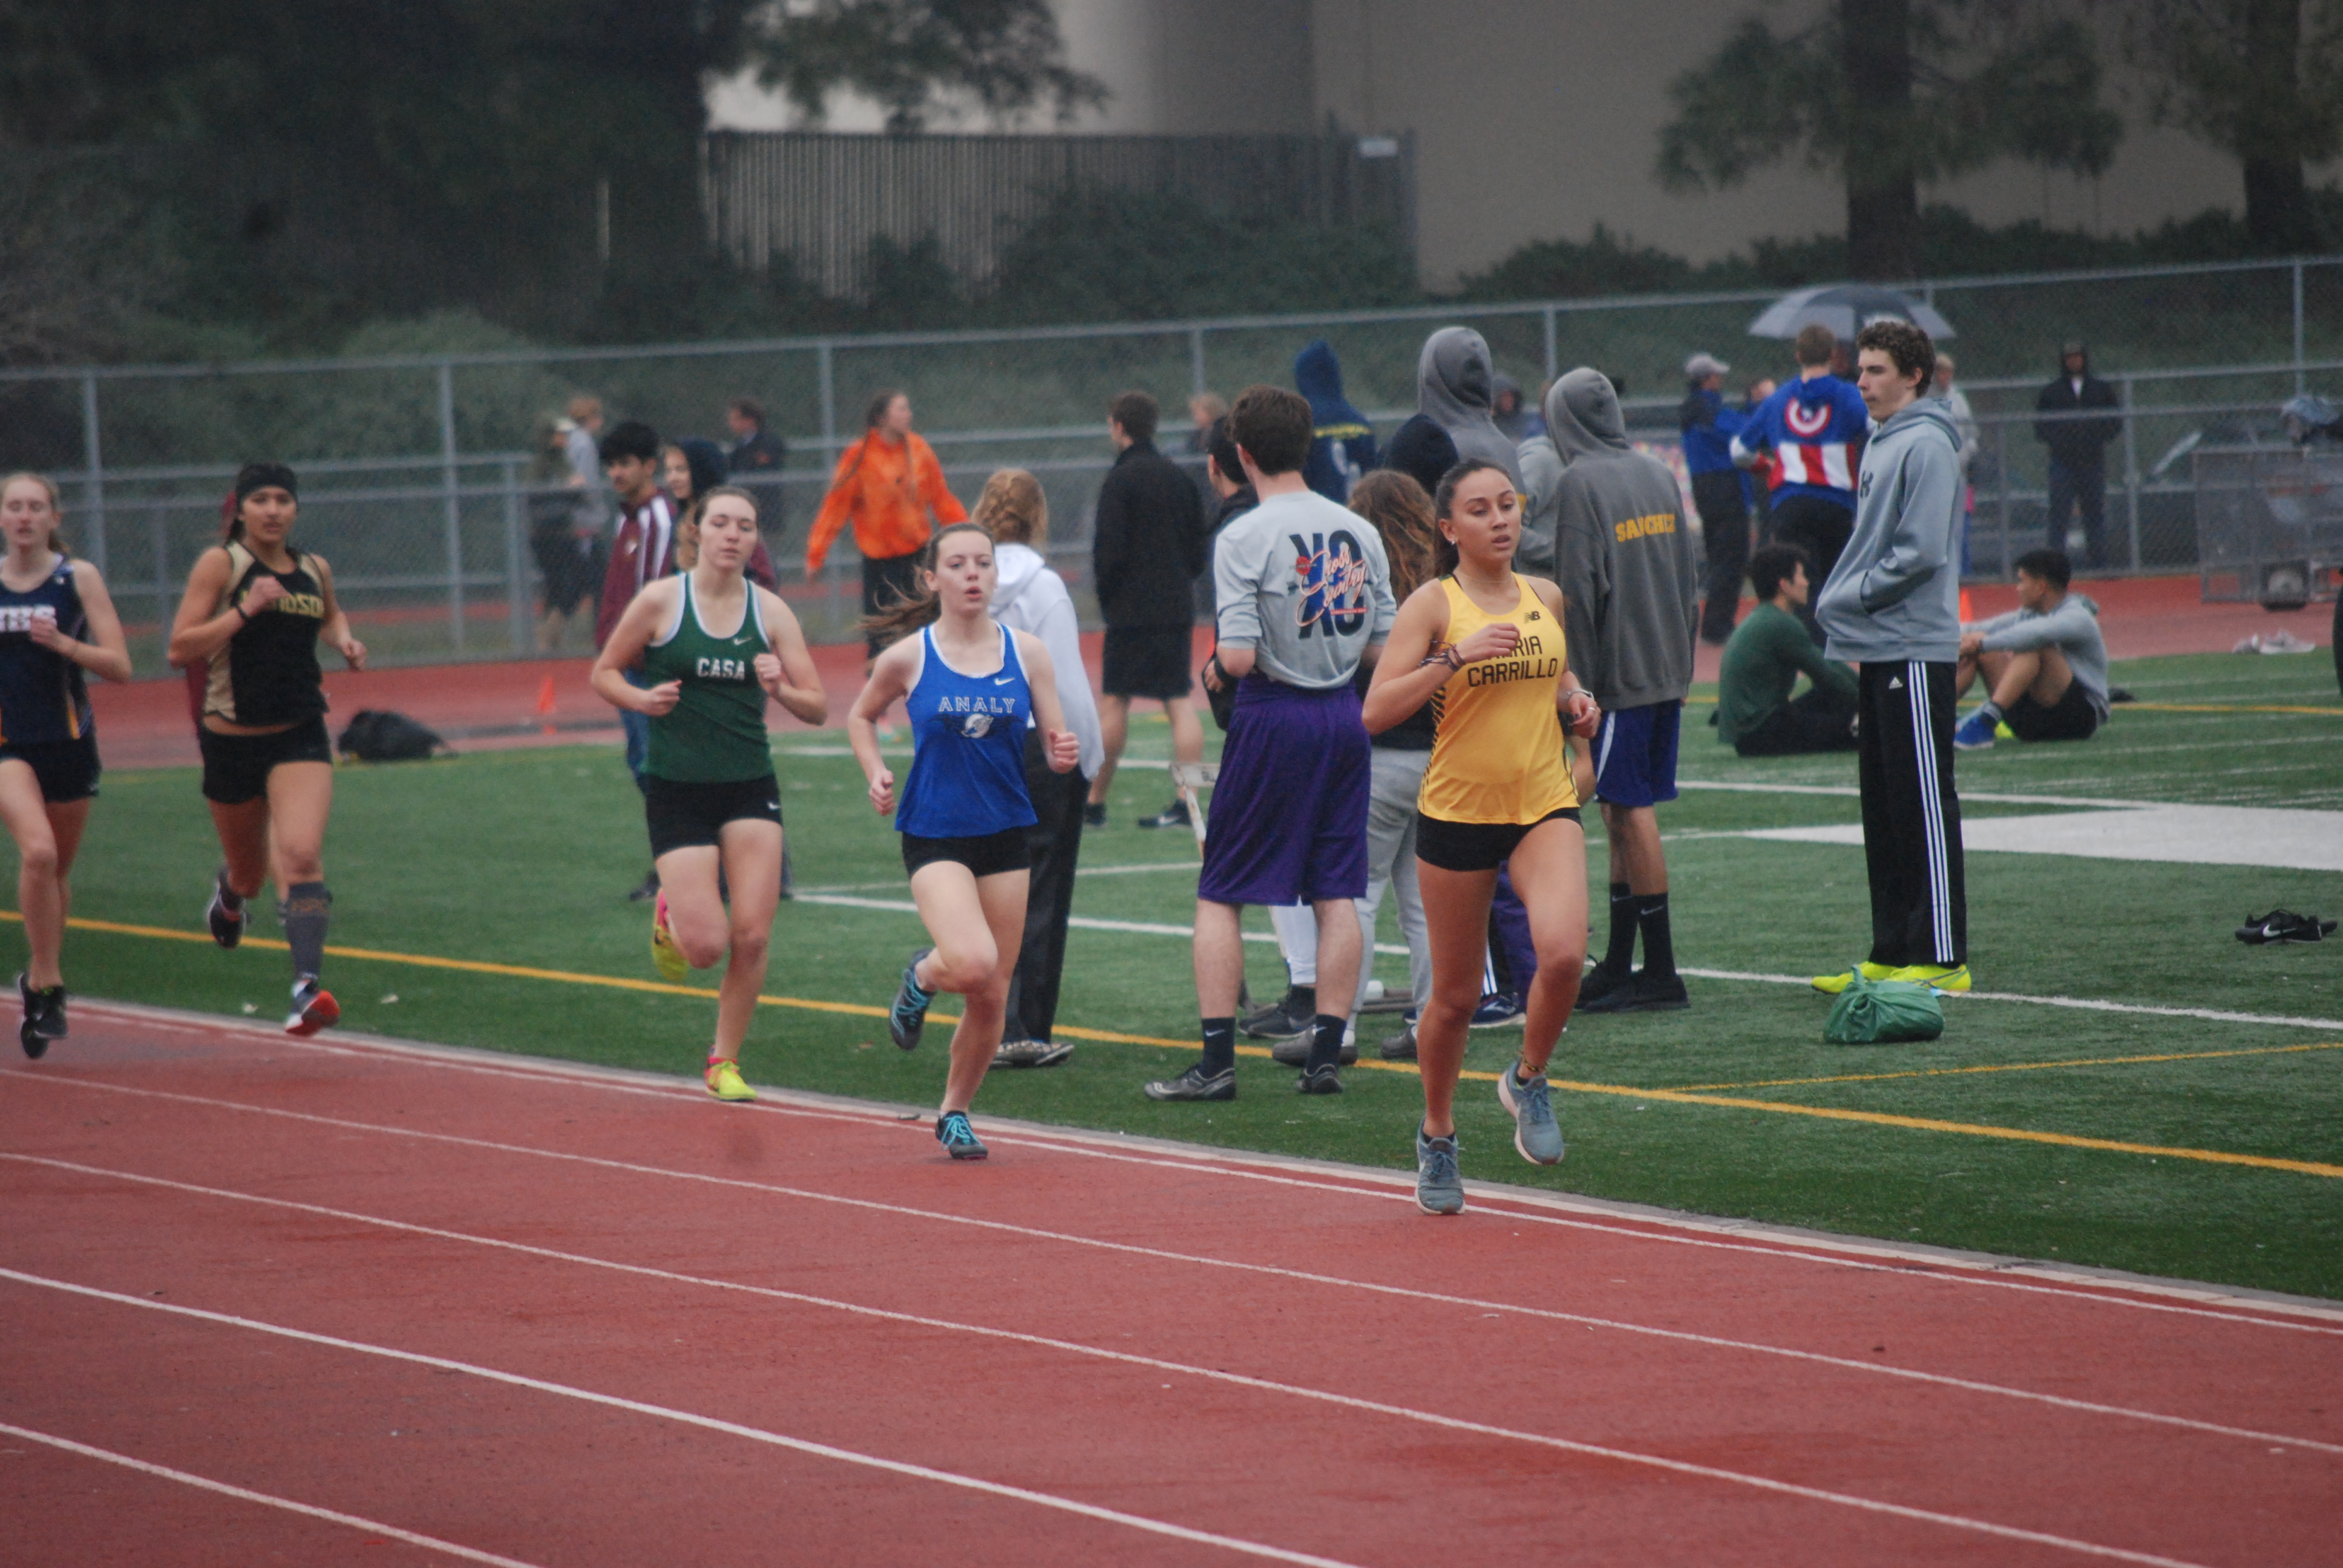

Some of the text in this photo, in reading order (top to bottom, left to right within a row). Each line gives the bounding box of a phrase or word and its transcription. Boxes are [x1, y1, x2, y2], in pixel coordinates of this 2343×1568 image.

[1615, 514, 1676, 543] SANCHZ
[1487, 636, 1542, 660] RIA
[697, 658, 745, 680] CASA
[1467, 658, 1558, 687] CARRILLO
[939, 696, 1016, 714] ANALY
